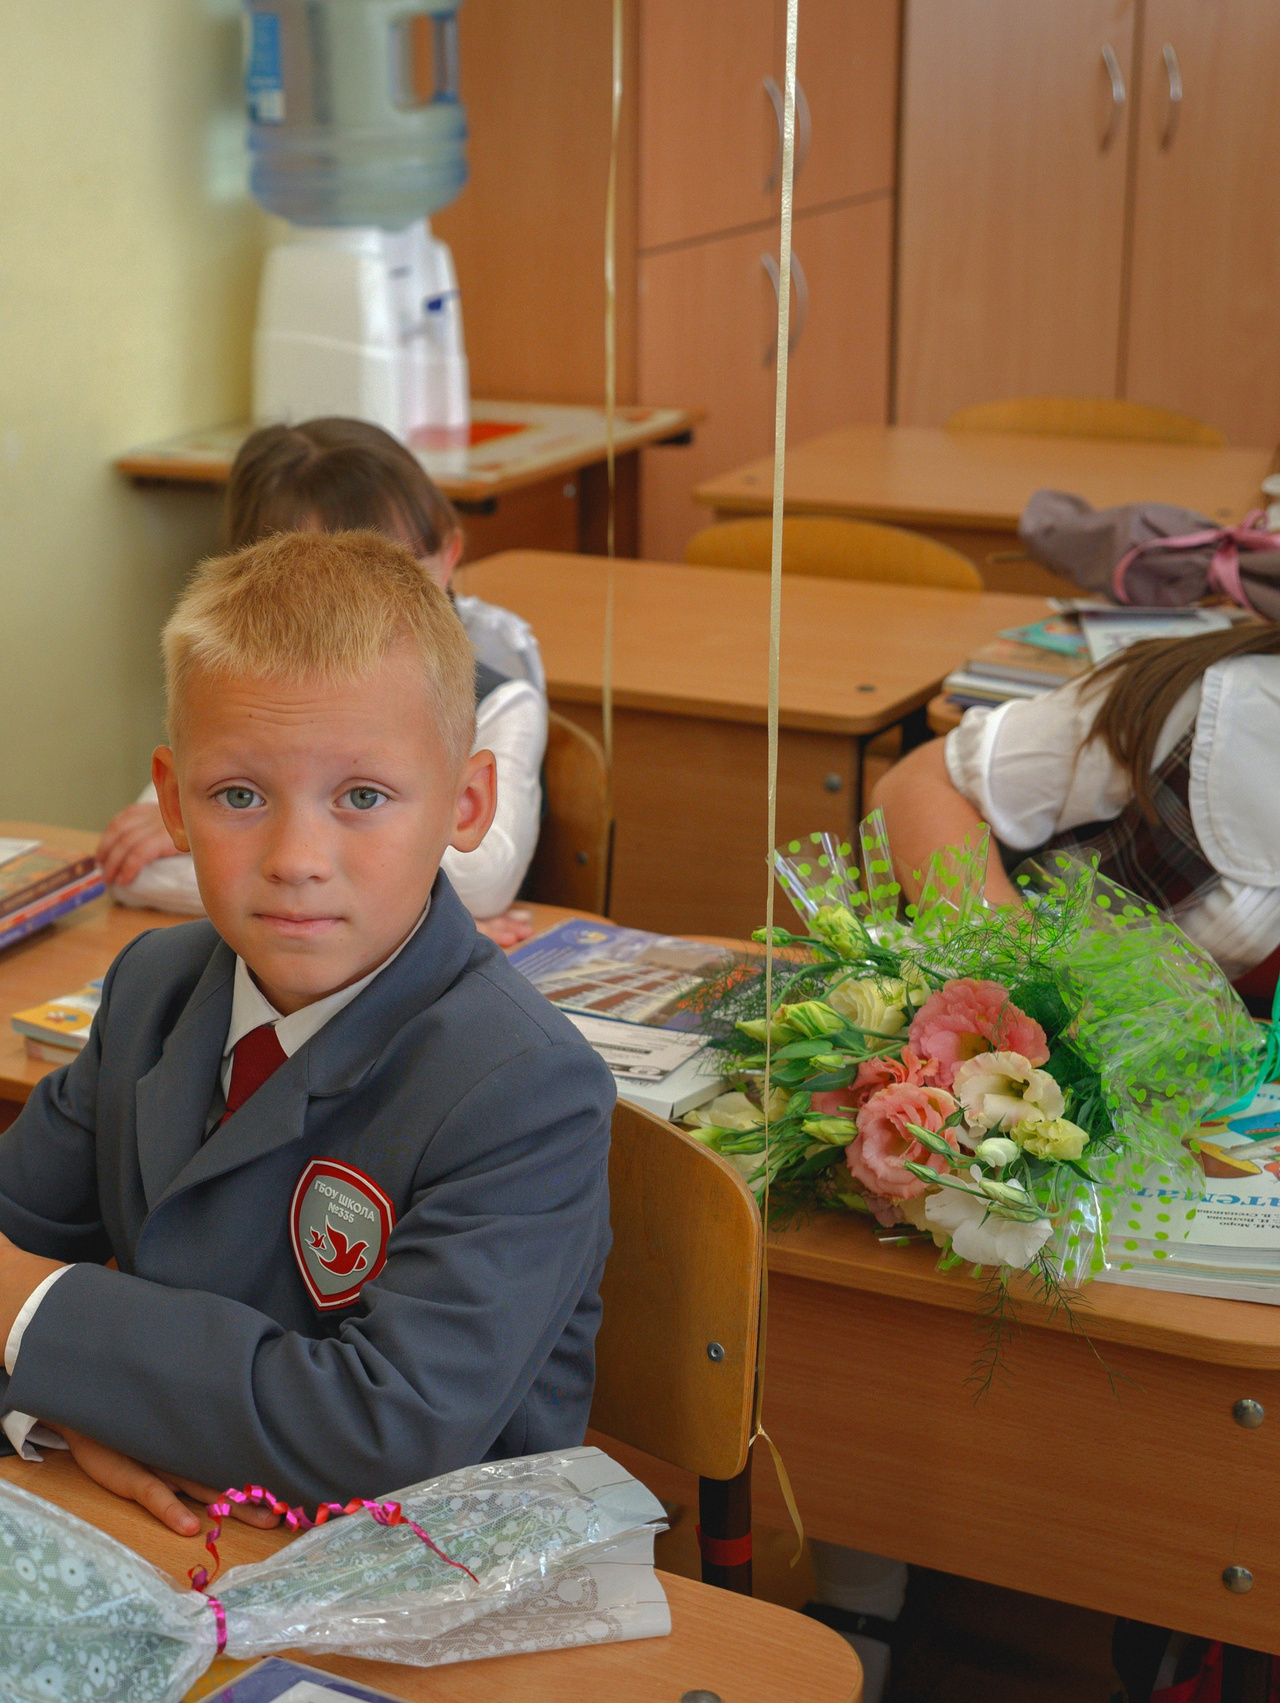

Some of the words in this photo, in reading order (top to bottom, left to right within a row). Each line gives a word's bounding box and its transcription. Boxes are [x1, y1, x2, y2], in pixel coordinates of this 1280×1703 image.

[314, 1180, 339, 1200] ГБОУ
[338, 1193, 375, 1222] ШКОЛА
[327, 1201, 355, 1223] №335
